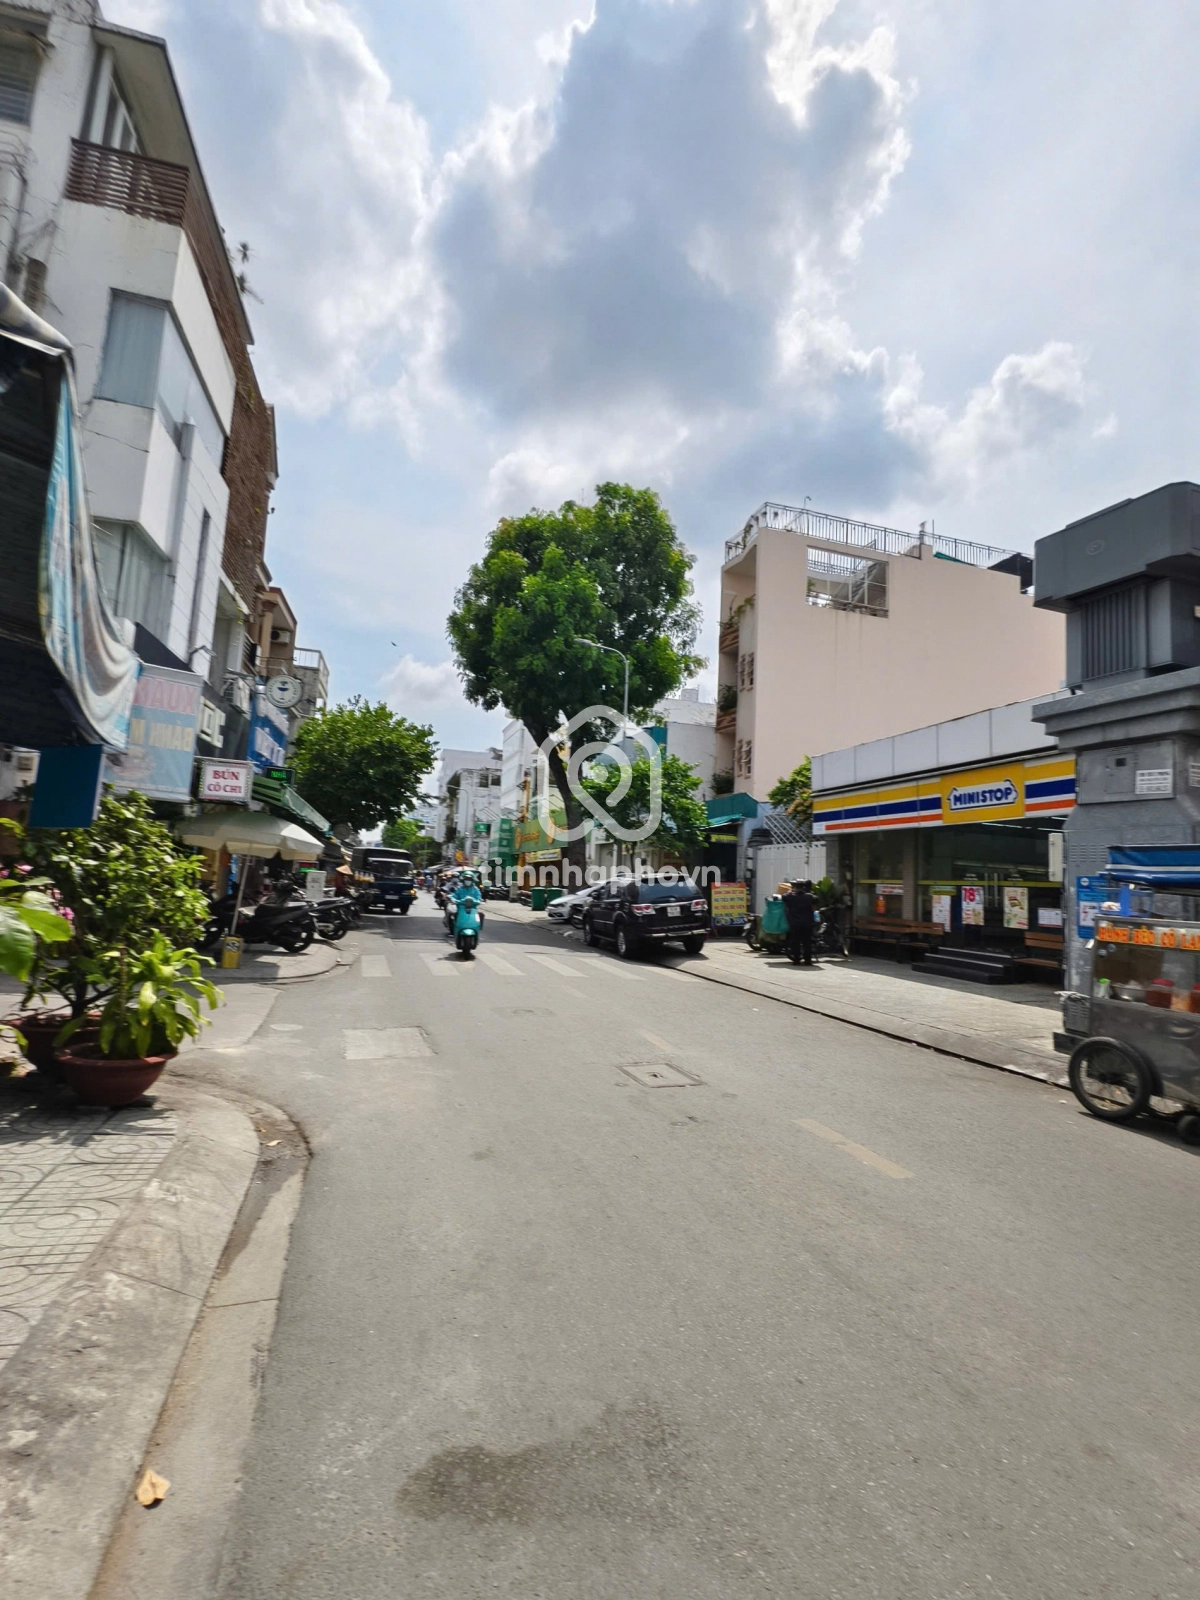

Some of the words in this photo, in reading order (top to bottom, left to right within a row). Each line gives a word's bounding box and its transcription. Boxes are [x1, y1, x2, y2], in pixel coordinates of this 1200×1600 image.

[212, 768, 240, 780] BÚN
[207, 781, 221, 792] CÔ
[953, 786, 1013, 806] MINISTOP
